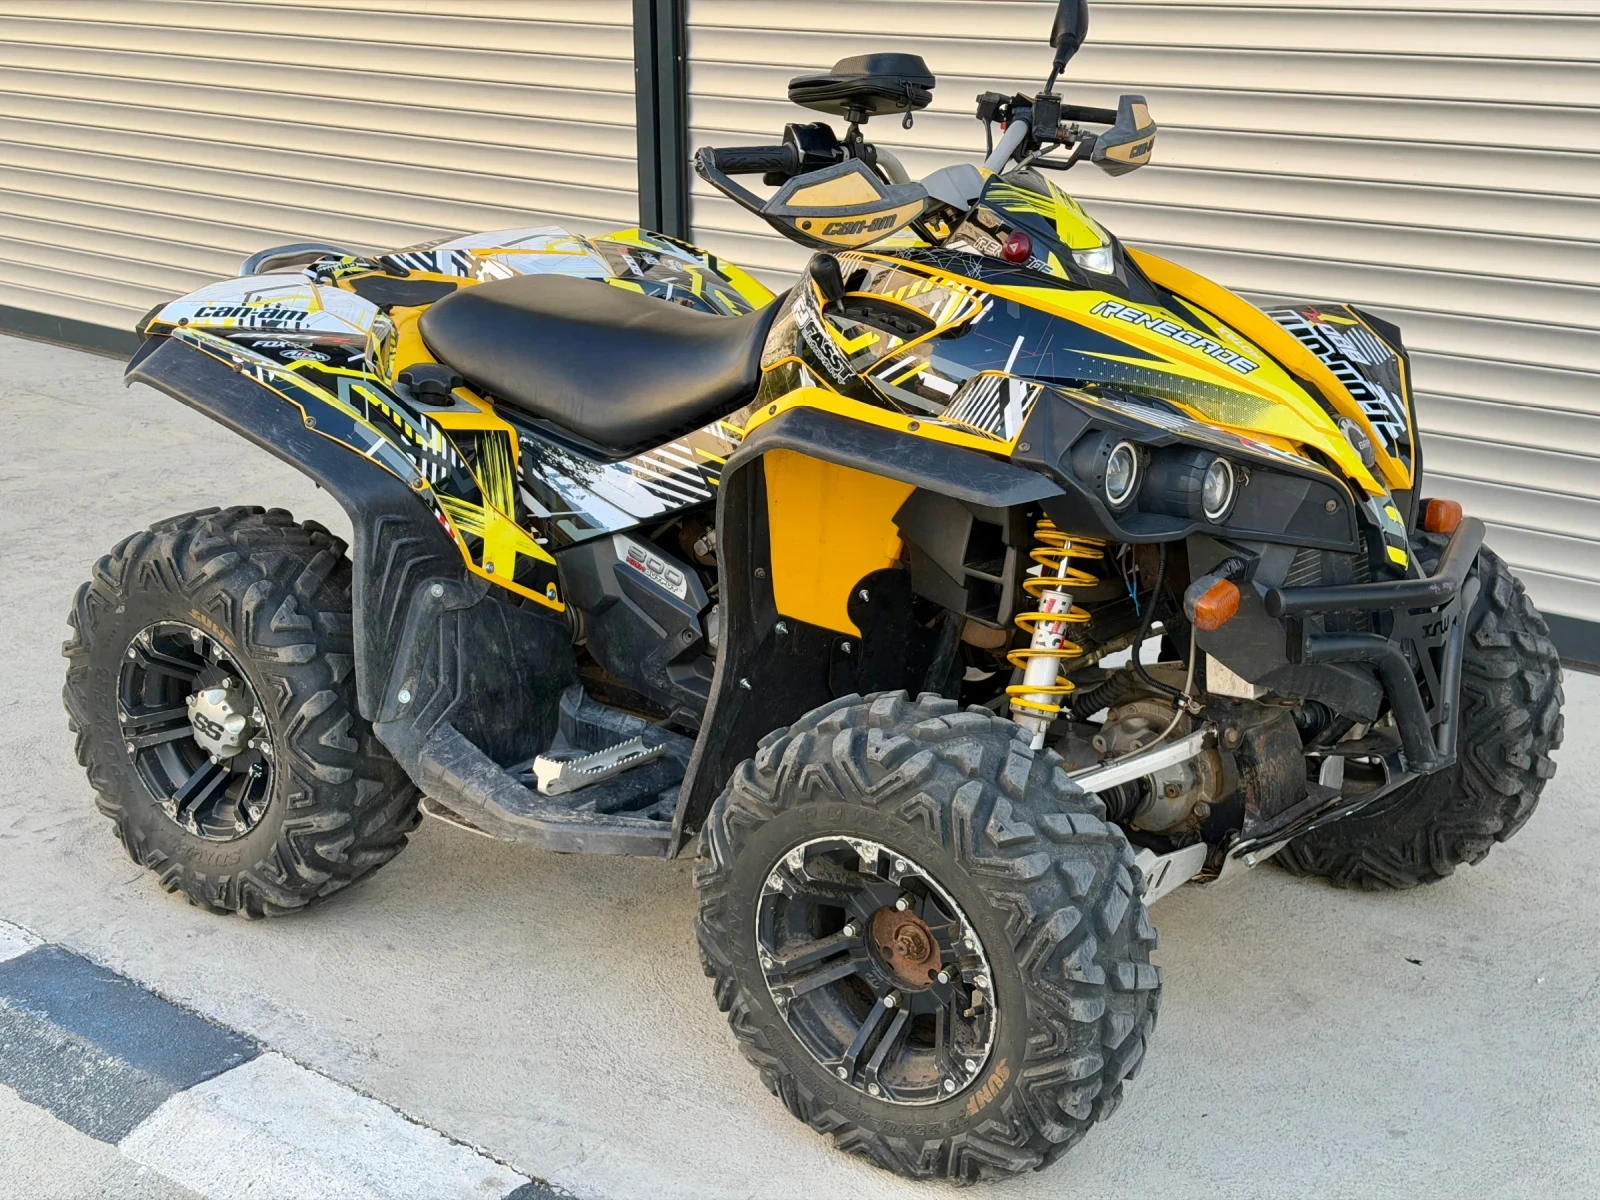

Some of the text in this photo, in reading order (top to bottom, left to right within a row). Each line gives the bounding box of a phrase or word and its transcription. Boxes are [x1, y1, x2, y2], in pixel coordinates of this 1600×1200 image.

[194, 306, 308, 321] can-am
[804, 319, 856, 381] FASST
[1090, 300, 1260, 375] RENEGADE
[626, 556, 679, 593] HIGH OUTPUT
[628, 544, 684, 587] 800
[193, 711, 225, 741] SS
